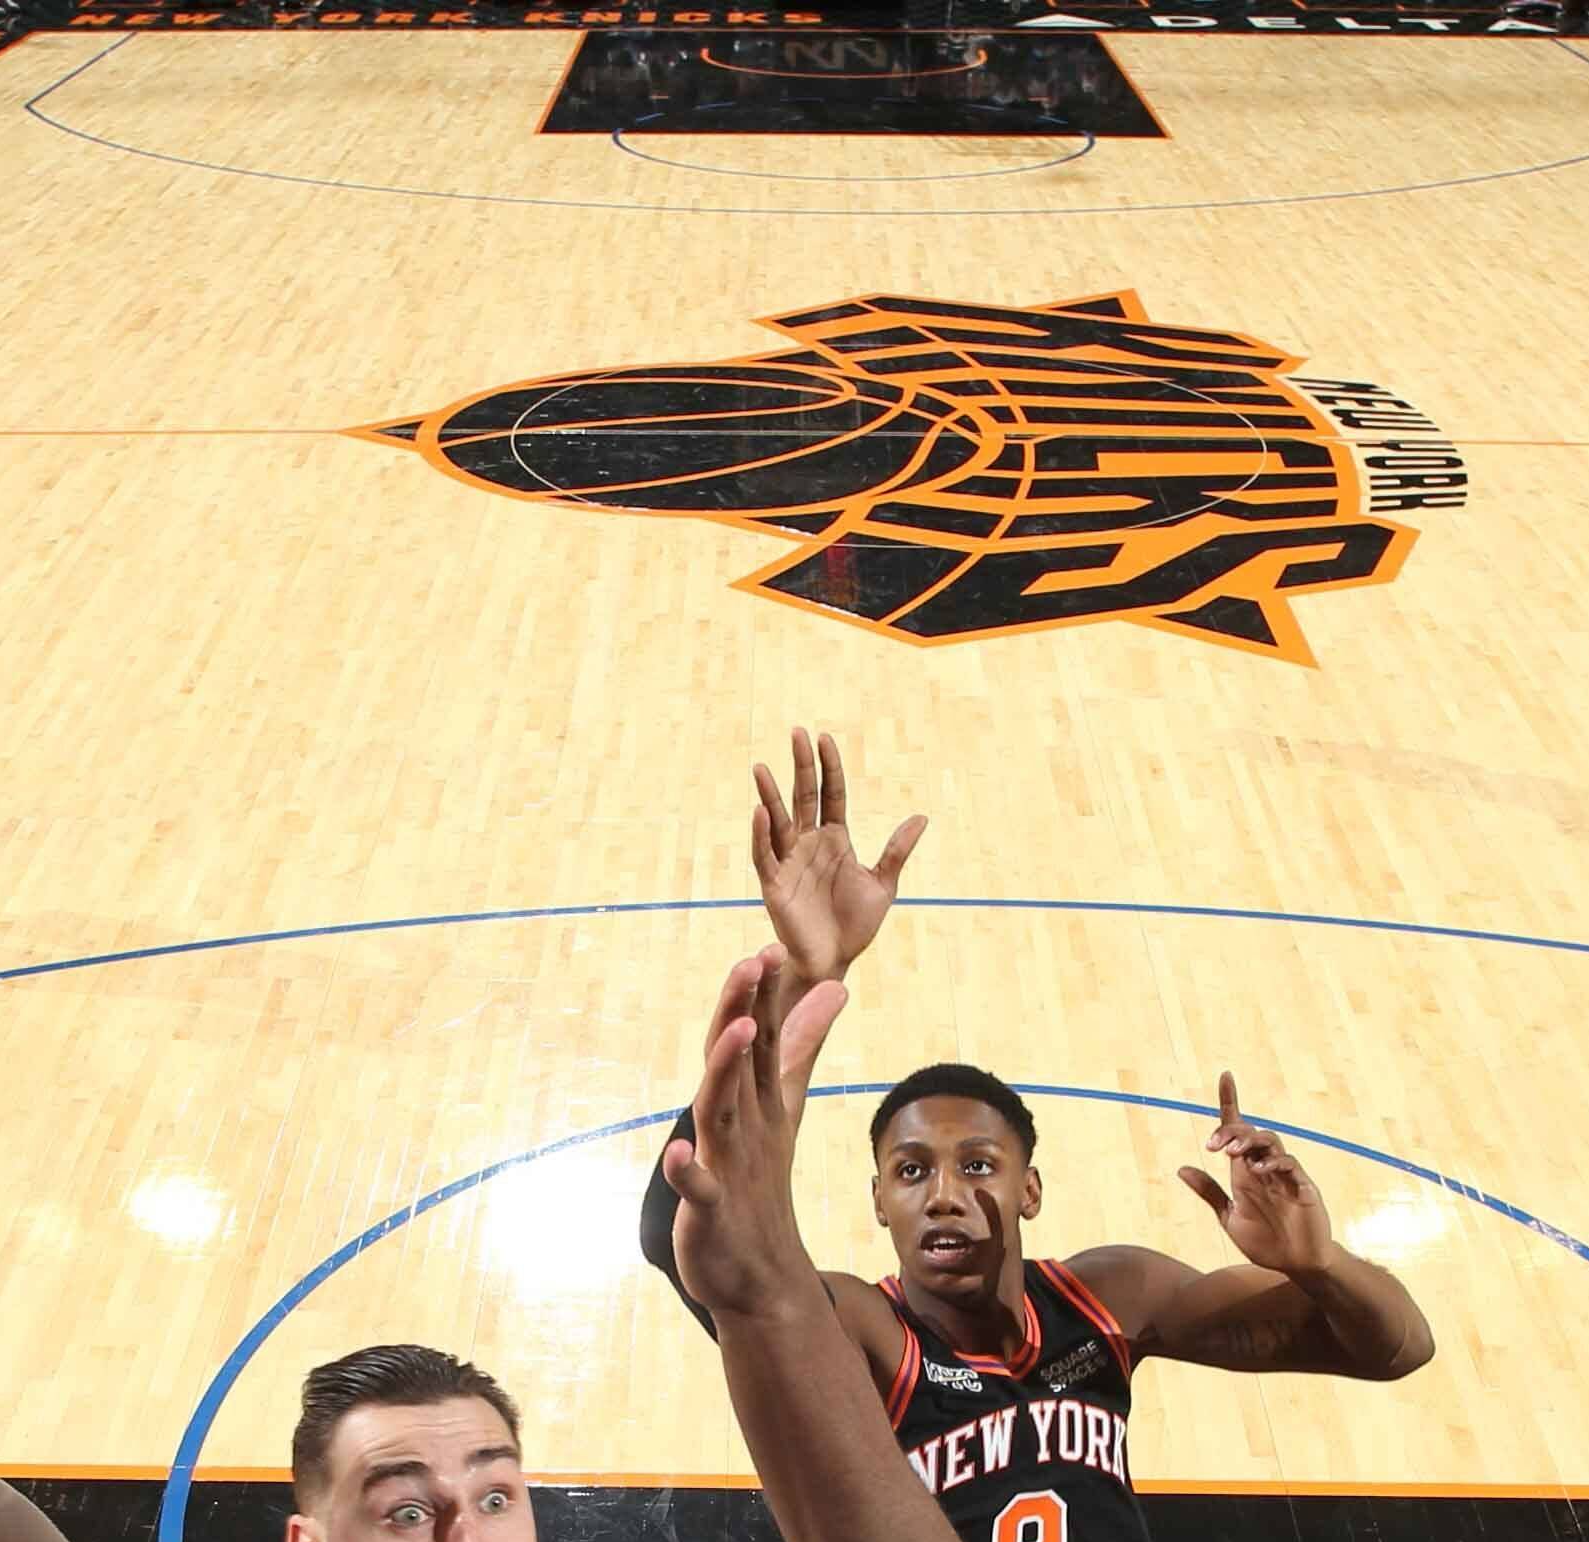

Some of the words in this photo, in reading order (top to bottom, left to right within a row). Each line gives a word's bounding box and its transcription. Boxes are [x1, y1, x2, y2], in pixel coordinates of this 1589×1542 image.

[69, 13, 223, 25] NEW
[272, 12, 477, 24] YORK
[523, 11, 822, 24] KNICKS
[1149, 14, 1559, 33] DELTA
[1286, 376, 1443, 433] NEW
[792, 292, 1402, 645] KNICKS
[1355, 439, 1470, 514] YORK
[1039, 1339, 1100, 1382] SQUARE
[1050, 1358, 1098, 1393] SPACE
[907, 1403, 1021, 1493] NEW
[1027, 1398, 1129, 1485] YORK
